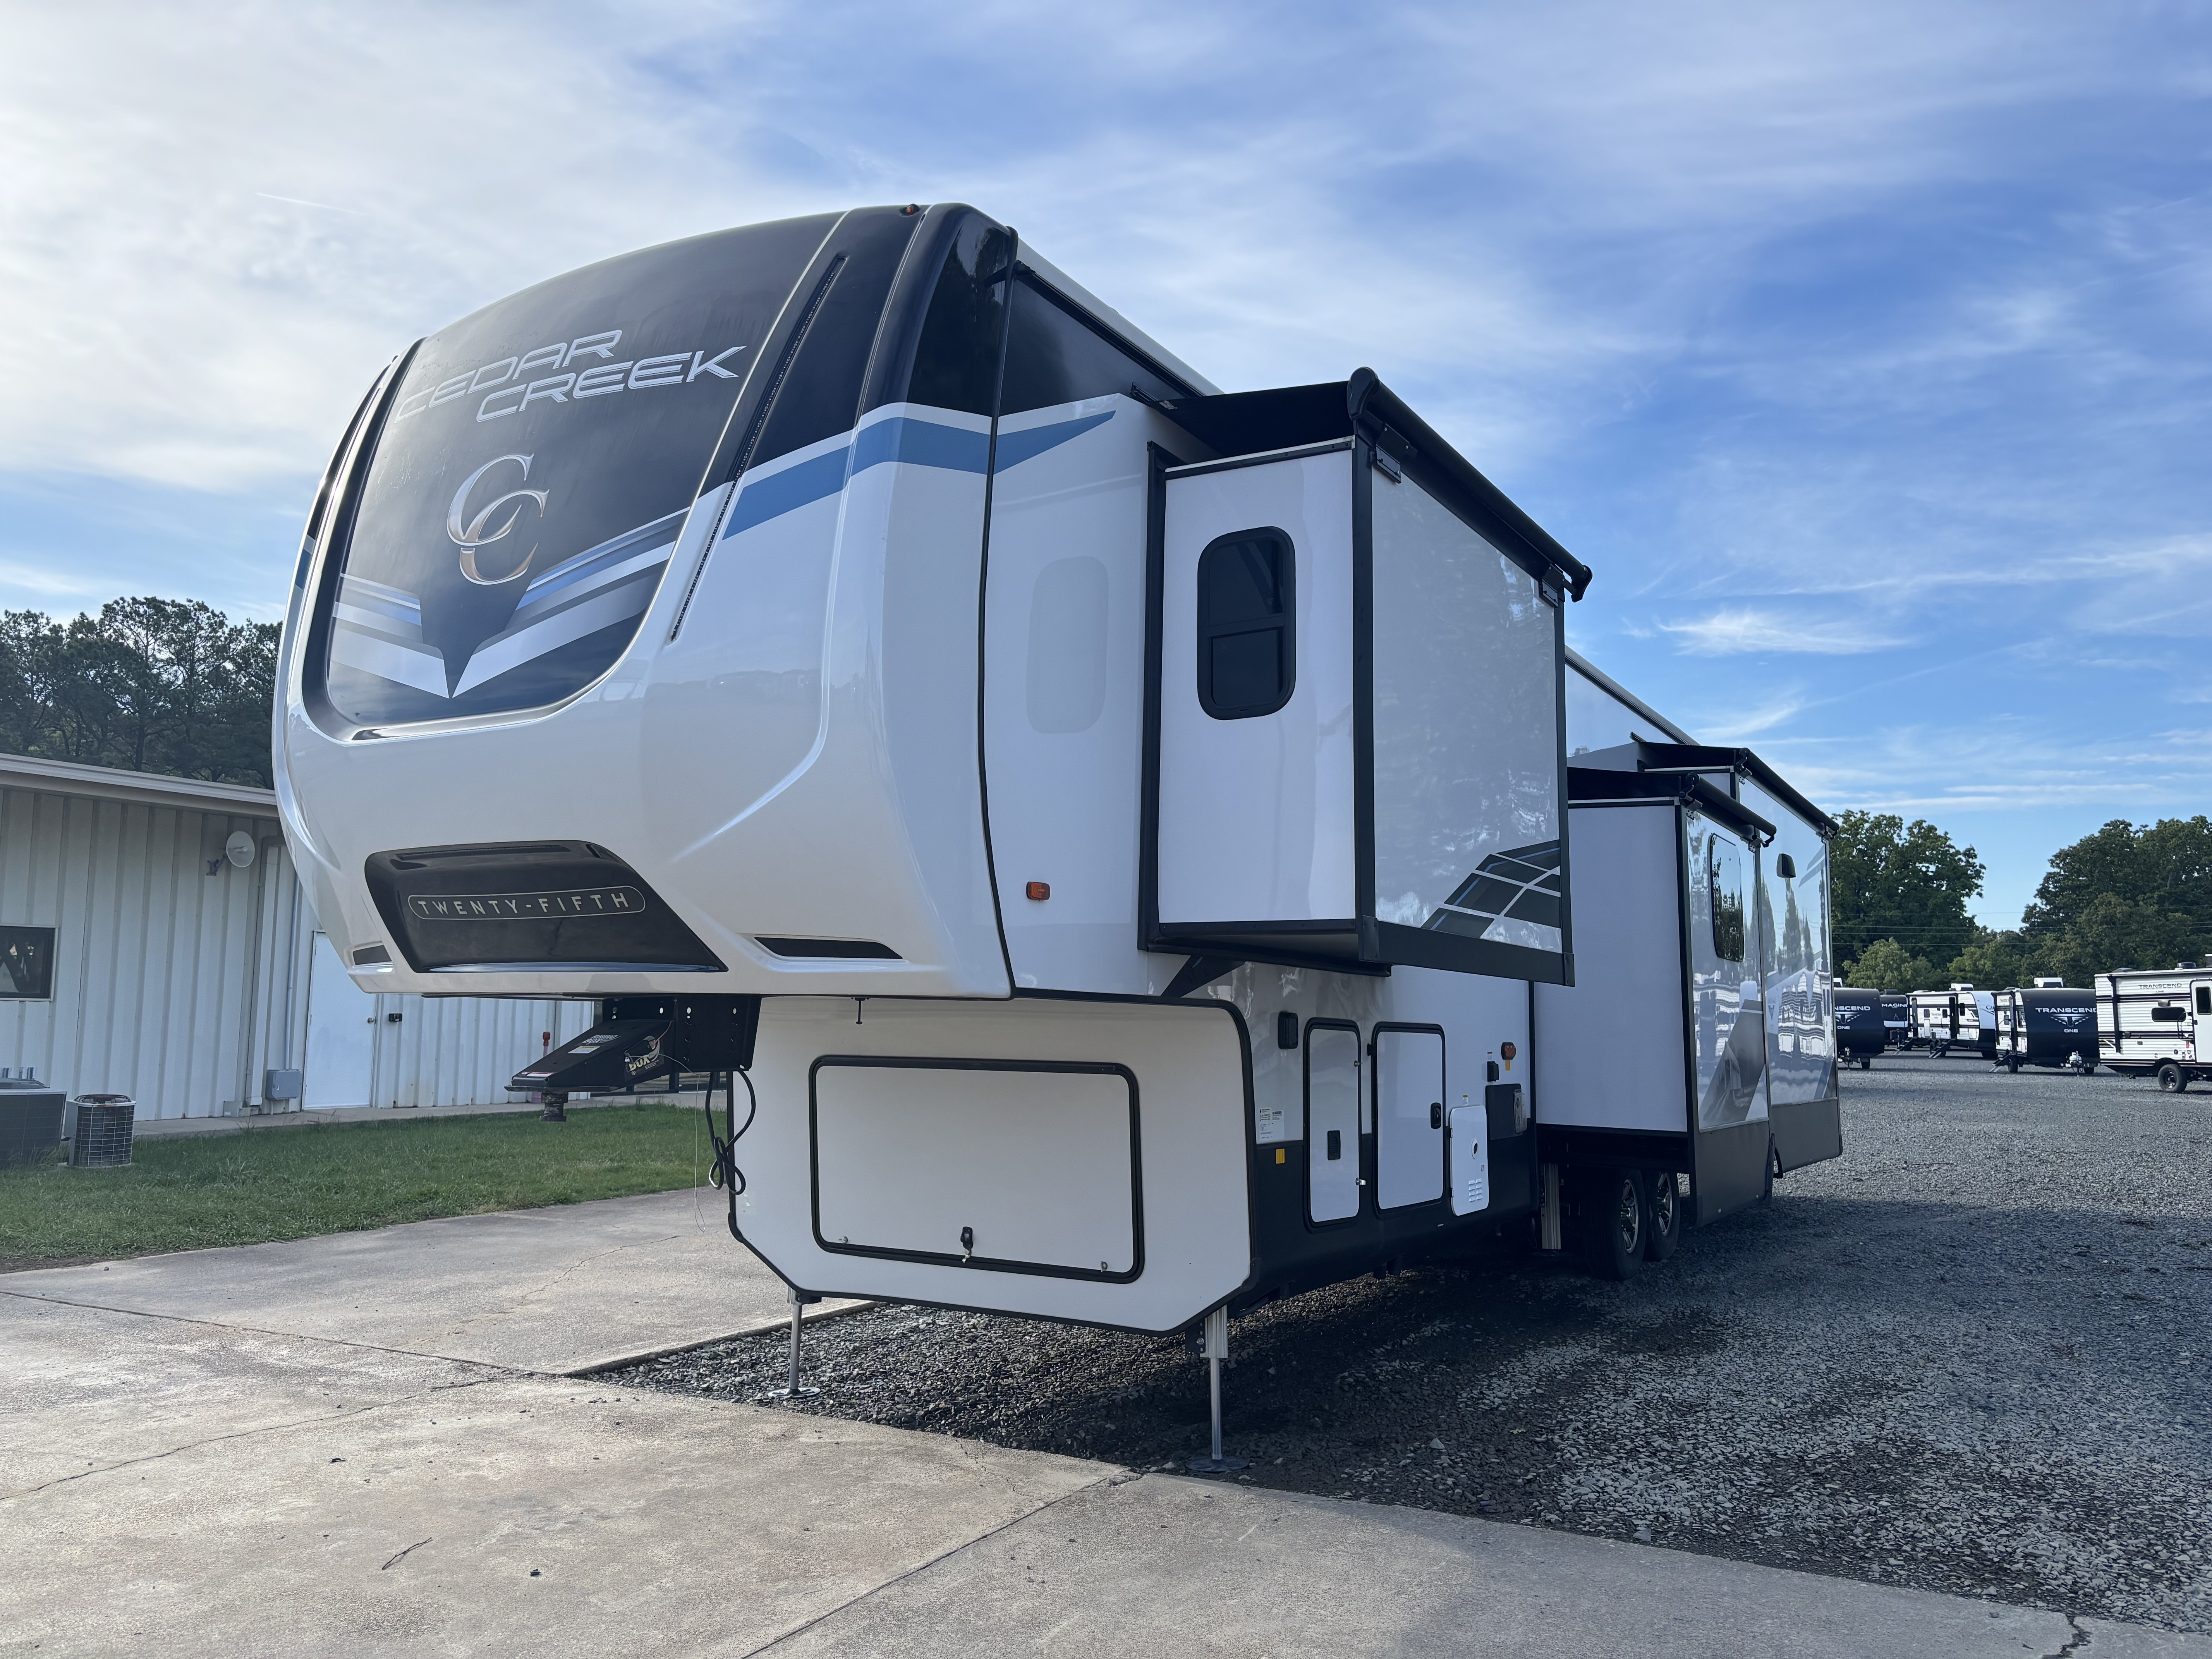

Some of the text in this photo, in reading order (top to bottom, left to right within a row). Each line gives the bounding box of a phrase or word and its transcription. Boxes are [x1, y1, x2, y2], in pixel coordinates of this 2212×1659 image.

[394, 330, 622, 424] CEDAR
[476, 346, 747, 422] CREEK
[418, 893, 629, 915] TWENTY-FIFTH
